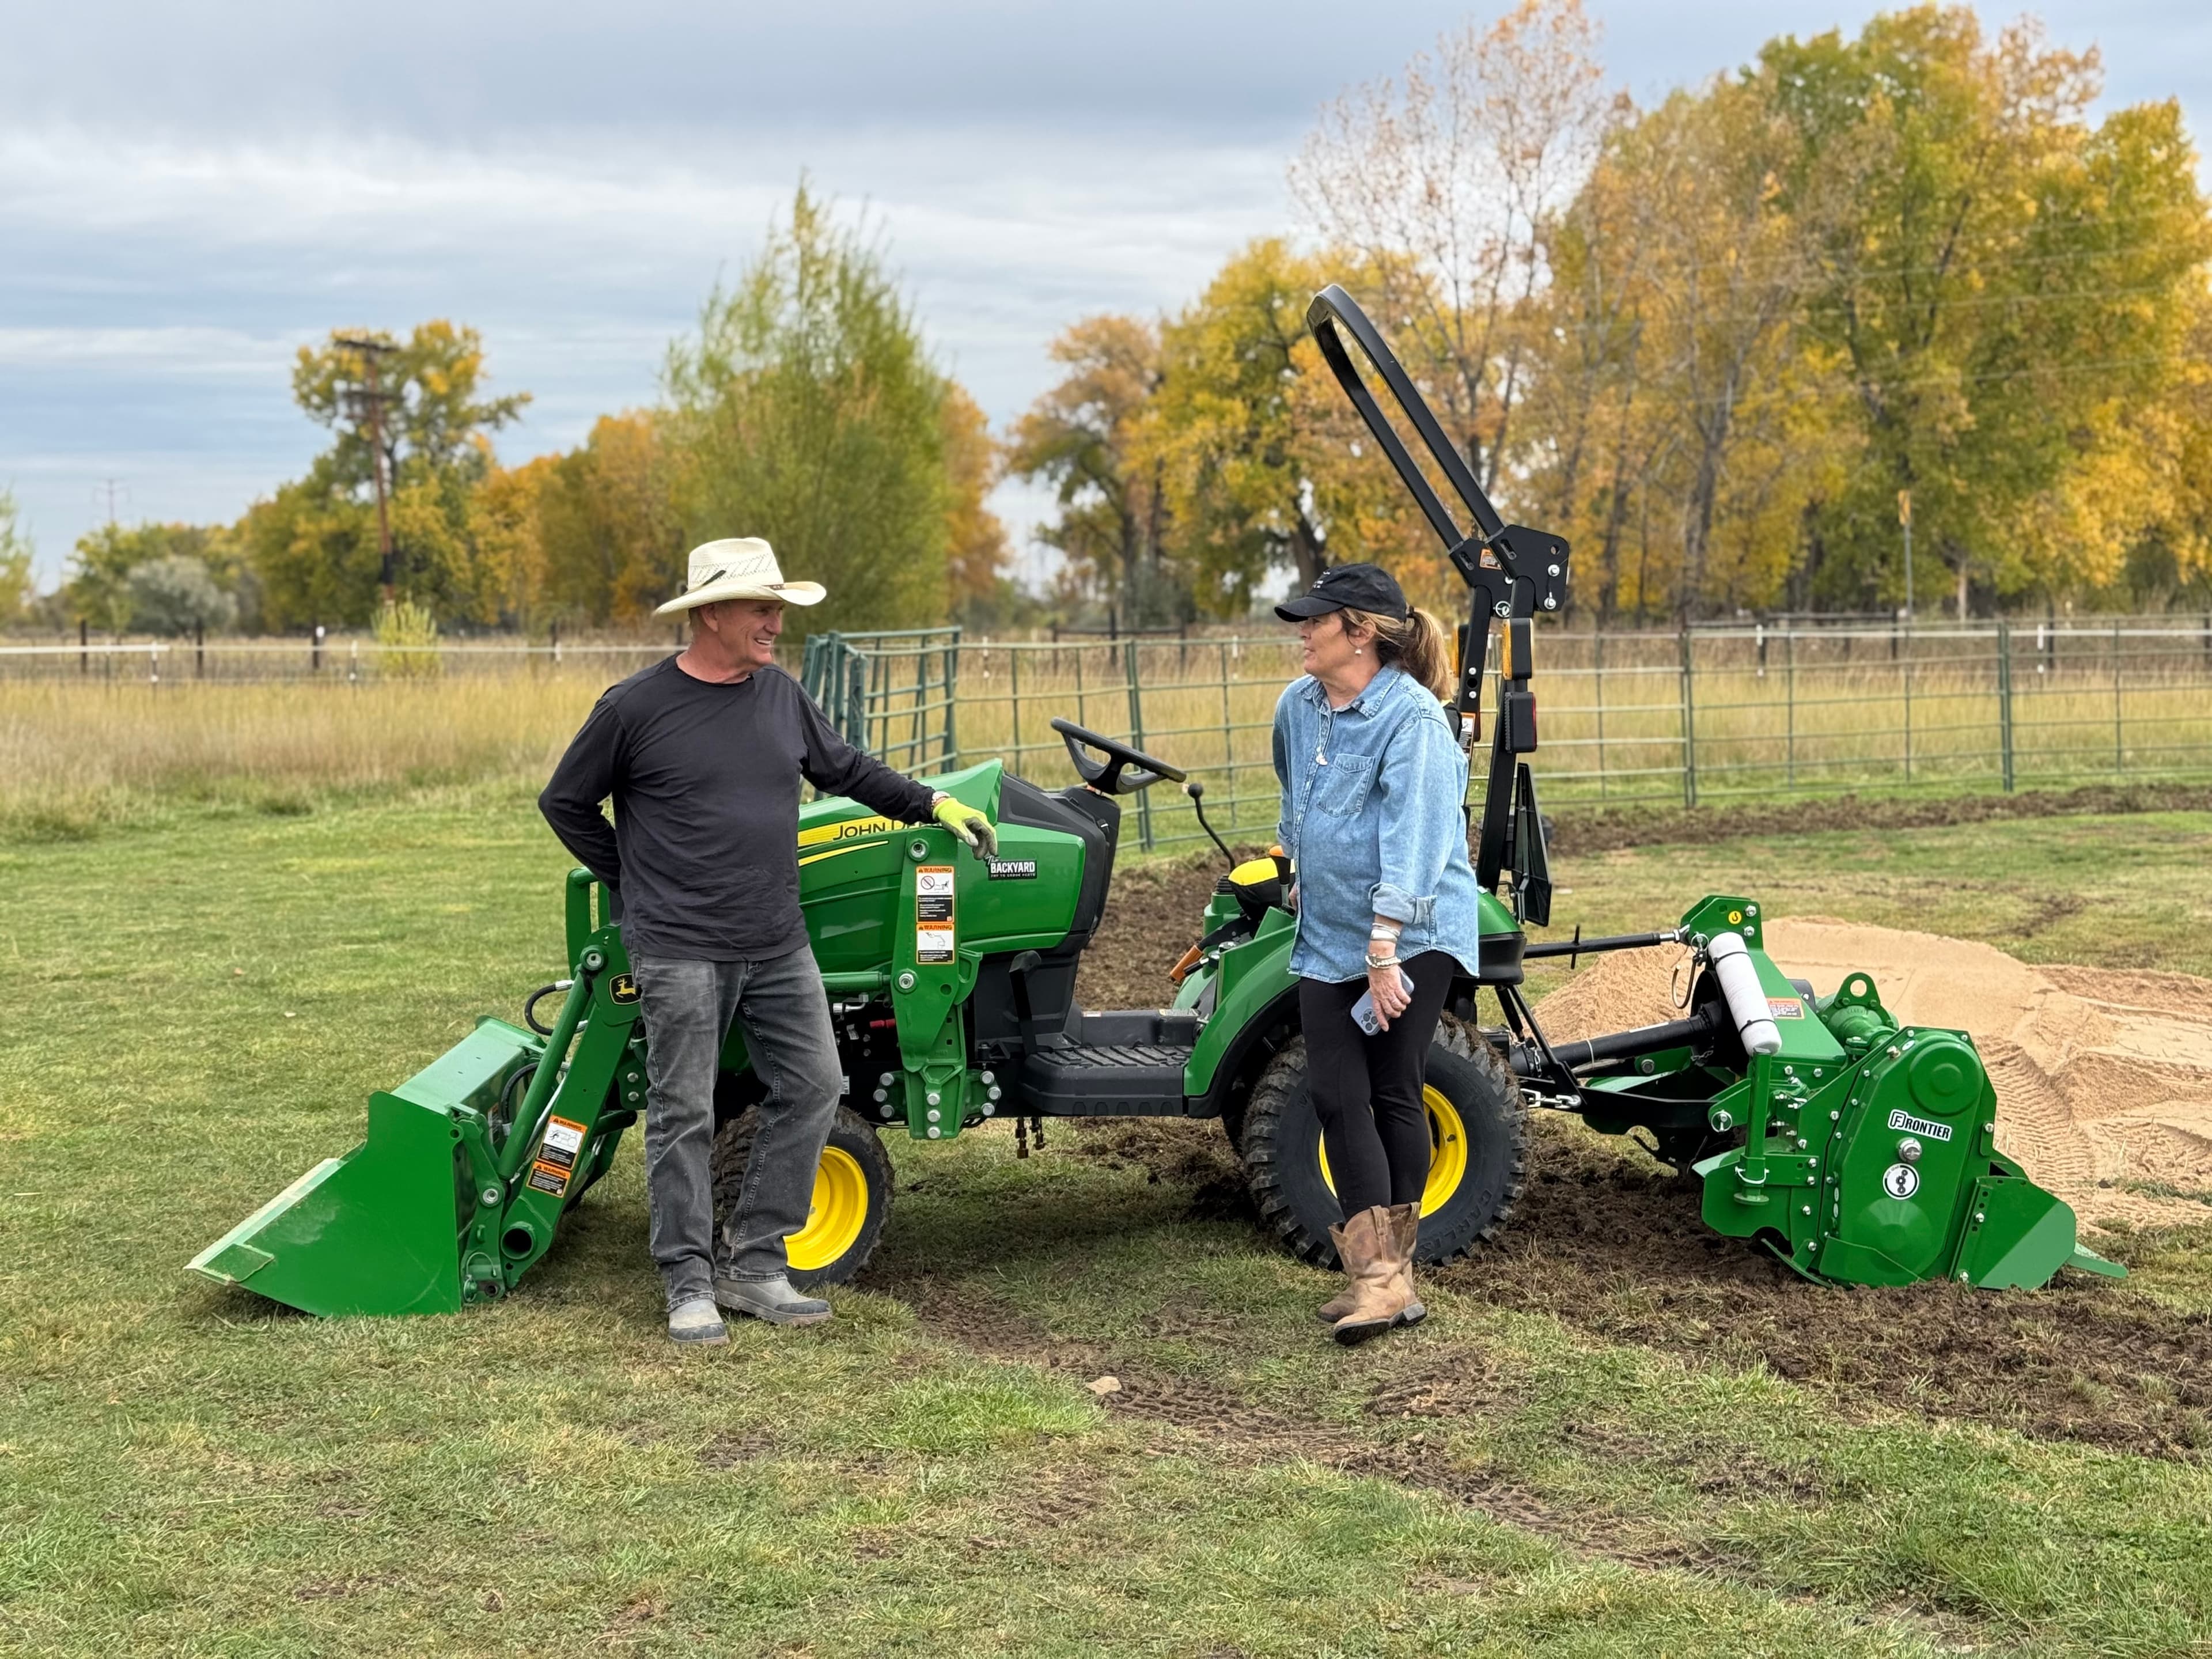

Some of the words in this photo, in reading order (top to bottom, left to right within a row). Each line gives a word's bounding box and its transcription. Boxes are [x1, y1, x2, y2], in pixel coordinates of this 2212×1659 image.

[833, 822, 885, 840] JOHN
[991, 862, 1035, 873] BACKYARD
[559, 1119, 582, 1131] WARNING
[1890, 1111, 1950, 1139] FRONTIER
[544, 1166, 566, 1177] WARNING
[1418, 1189, 1494, 1256] CARLIS
